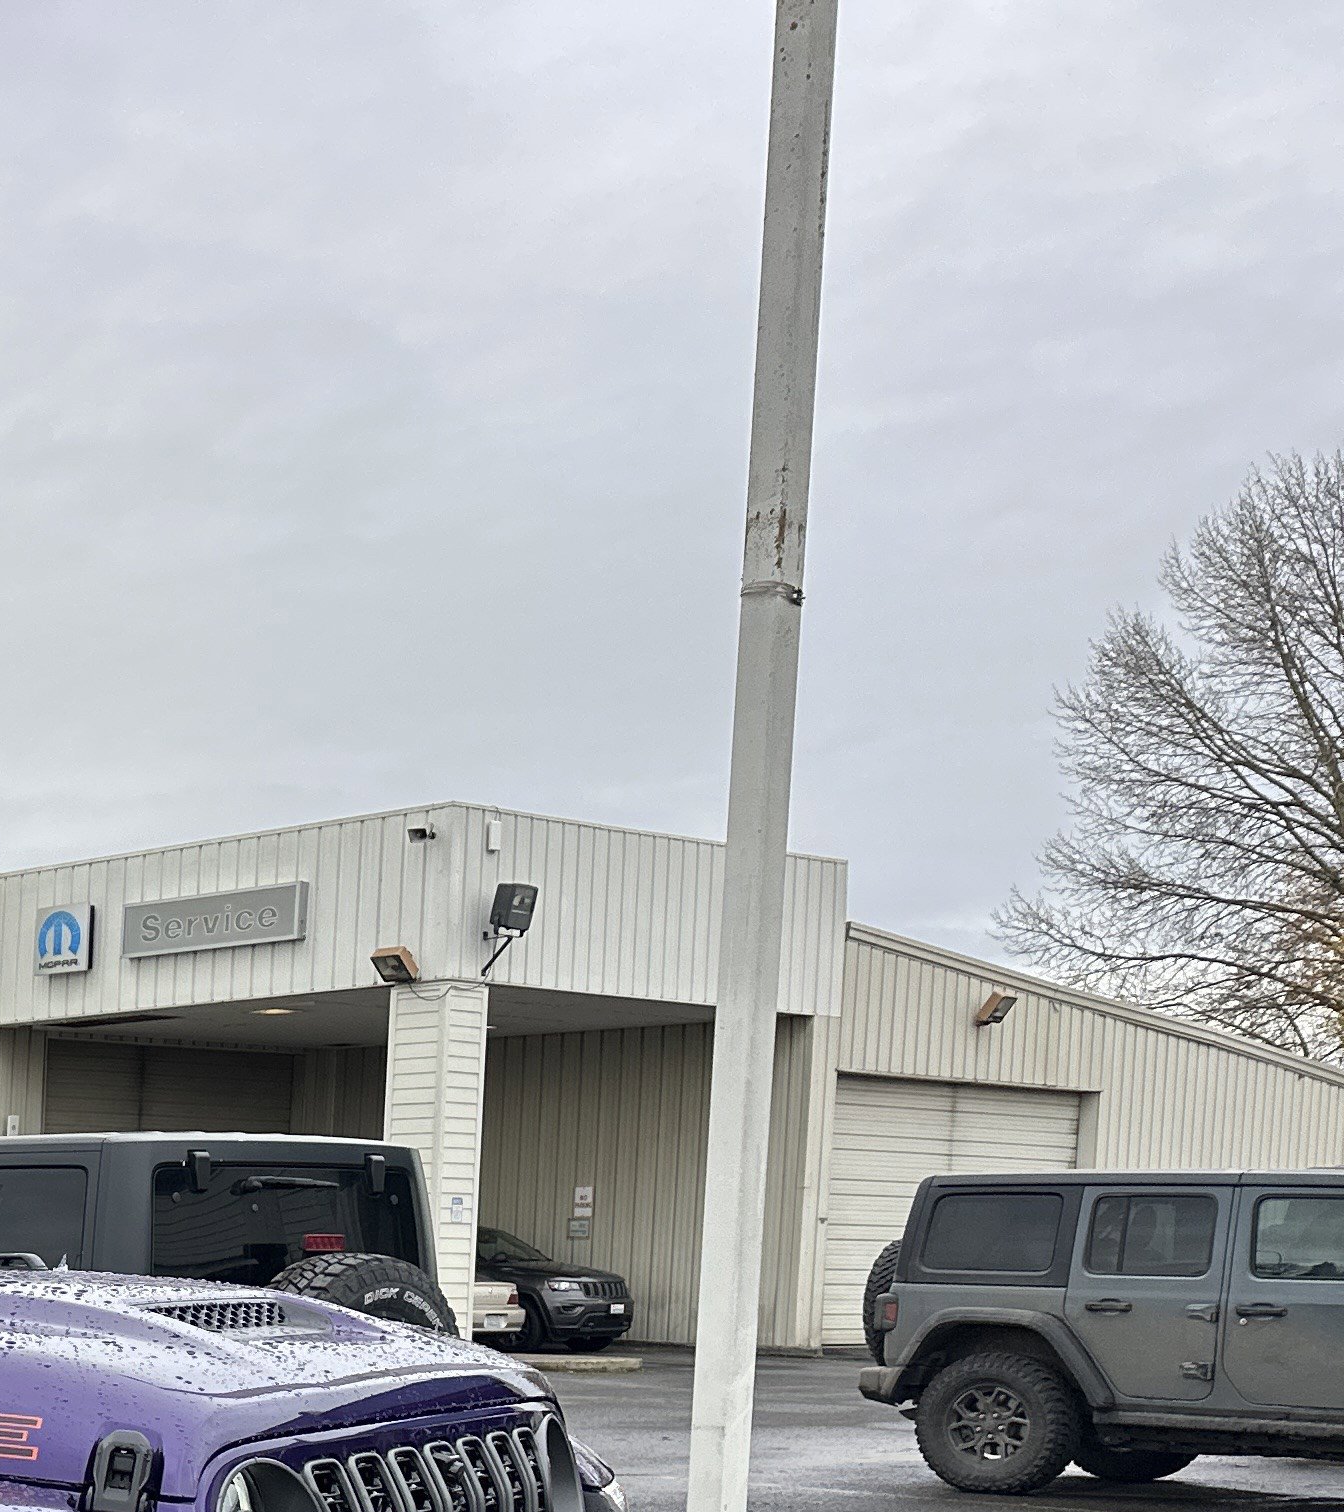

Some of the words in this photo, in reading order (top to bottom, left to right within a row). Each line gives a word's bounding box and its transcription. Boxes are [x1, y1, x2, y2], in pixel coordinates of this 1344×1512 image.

[141, 904, 278, 942] Service
[38, 958, 79, 970] MOPAR
[364, 1287, 400, 1305] DICK
